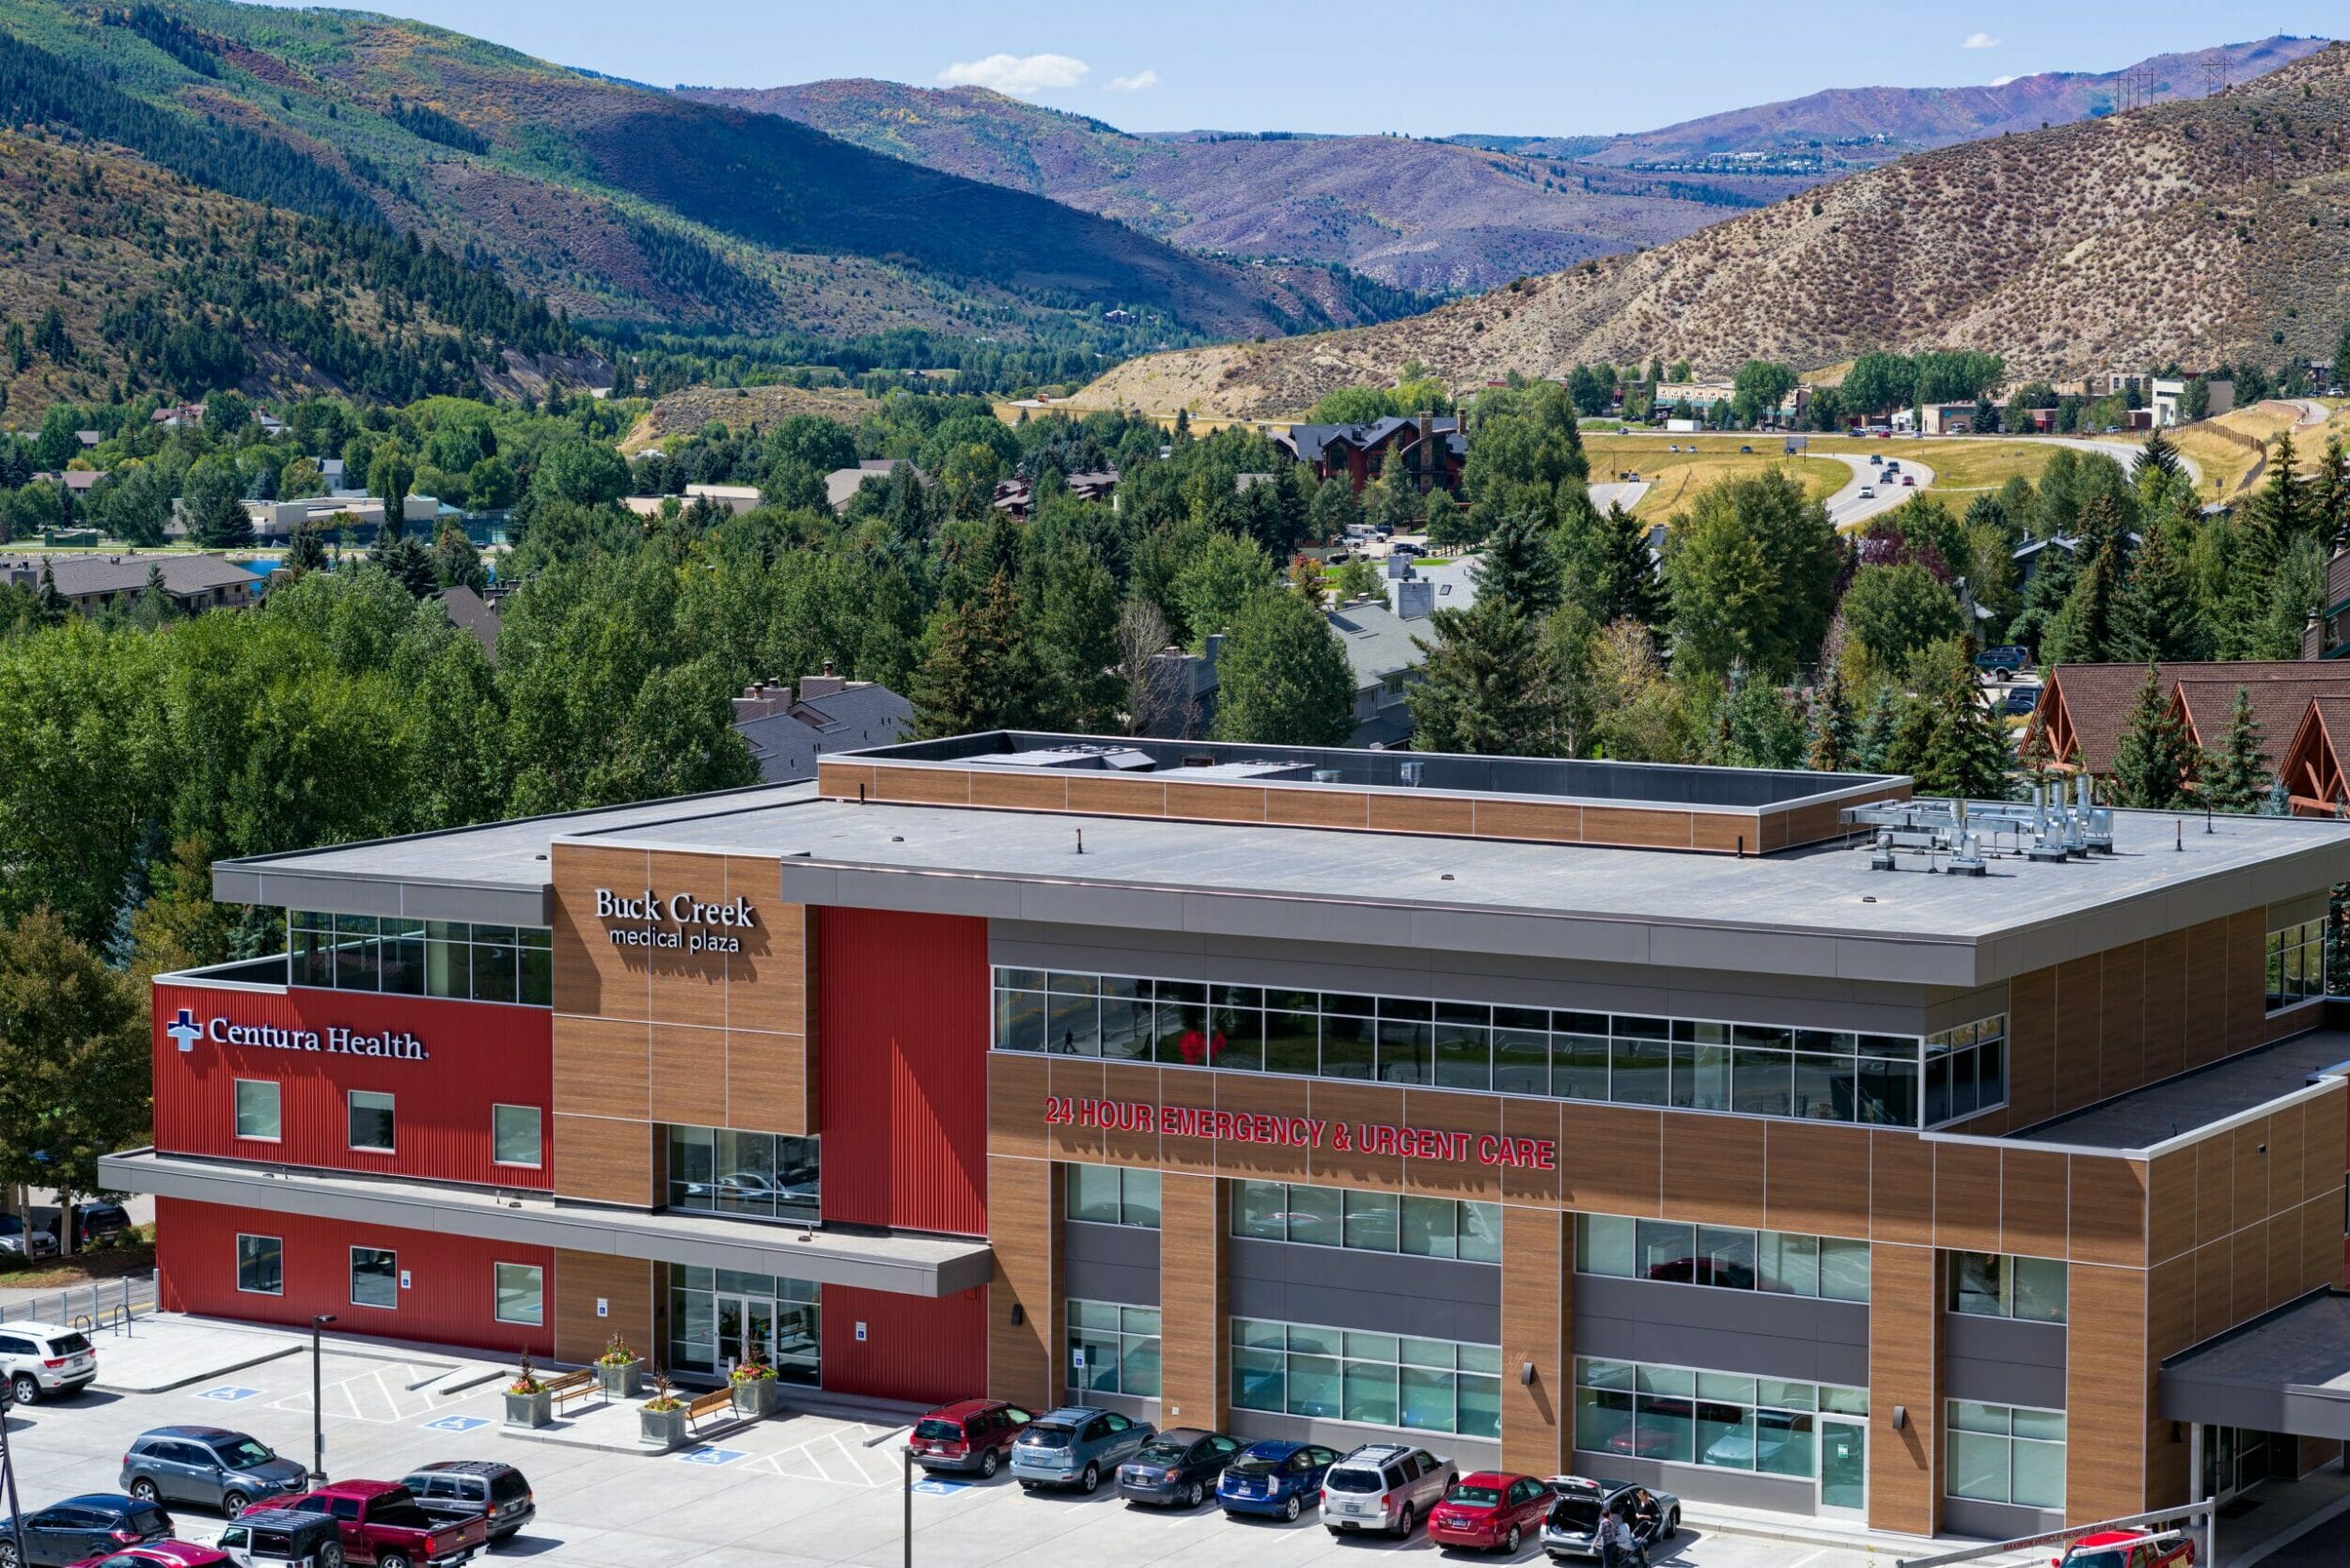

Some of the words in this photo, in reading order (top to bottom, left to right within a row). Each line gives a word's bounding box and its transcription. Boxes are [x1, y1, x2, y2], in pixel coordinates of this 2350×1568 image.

[595, 887, 663, 921] Buck
[669, 893, 755, 928] Creek
[609, 925, 682, 949] medical
[689, 928, 740, 955] plaza
[209, 1017, 321, 1052] Centura
[1045, 1096, 1073, 1124] 24
[1080, 1099, 1154, 1133] HOUR
[1159, 1105, 1326, 1148] EMERGENCY
[1332, 1121, 1353, 1152] &
[1357, 1123, 1474, 1162] URGENT
[1477, 1134, 1557, 1170] CARE
[2003, 1538, 2034, 1551] MAXIMUM
[2035, 1532, 2061, 1545] VEHICLE
